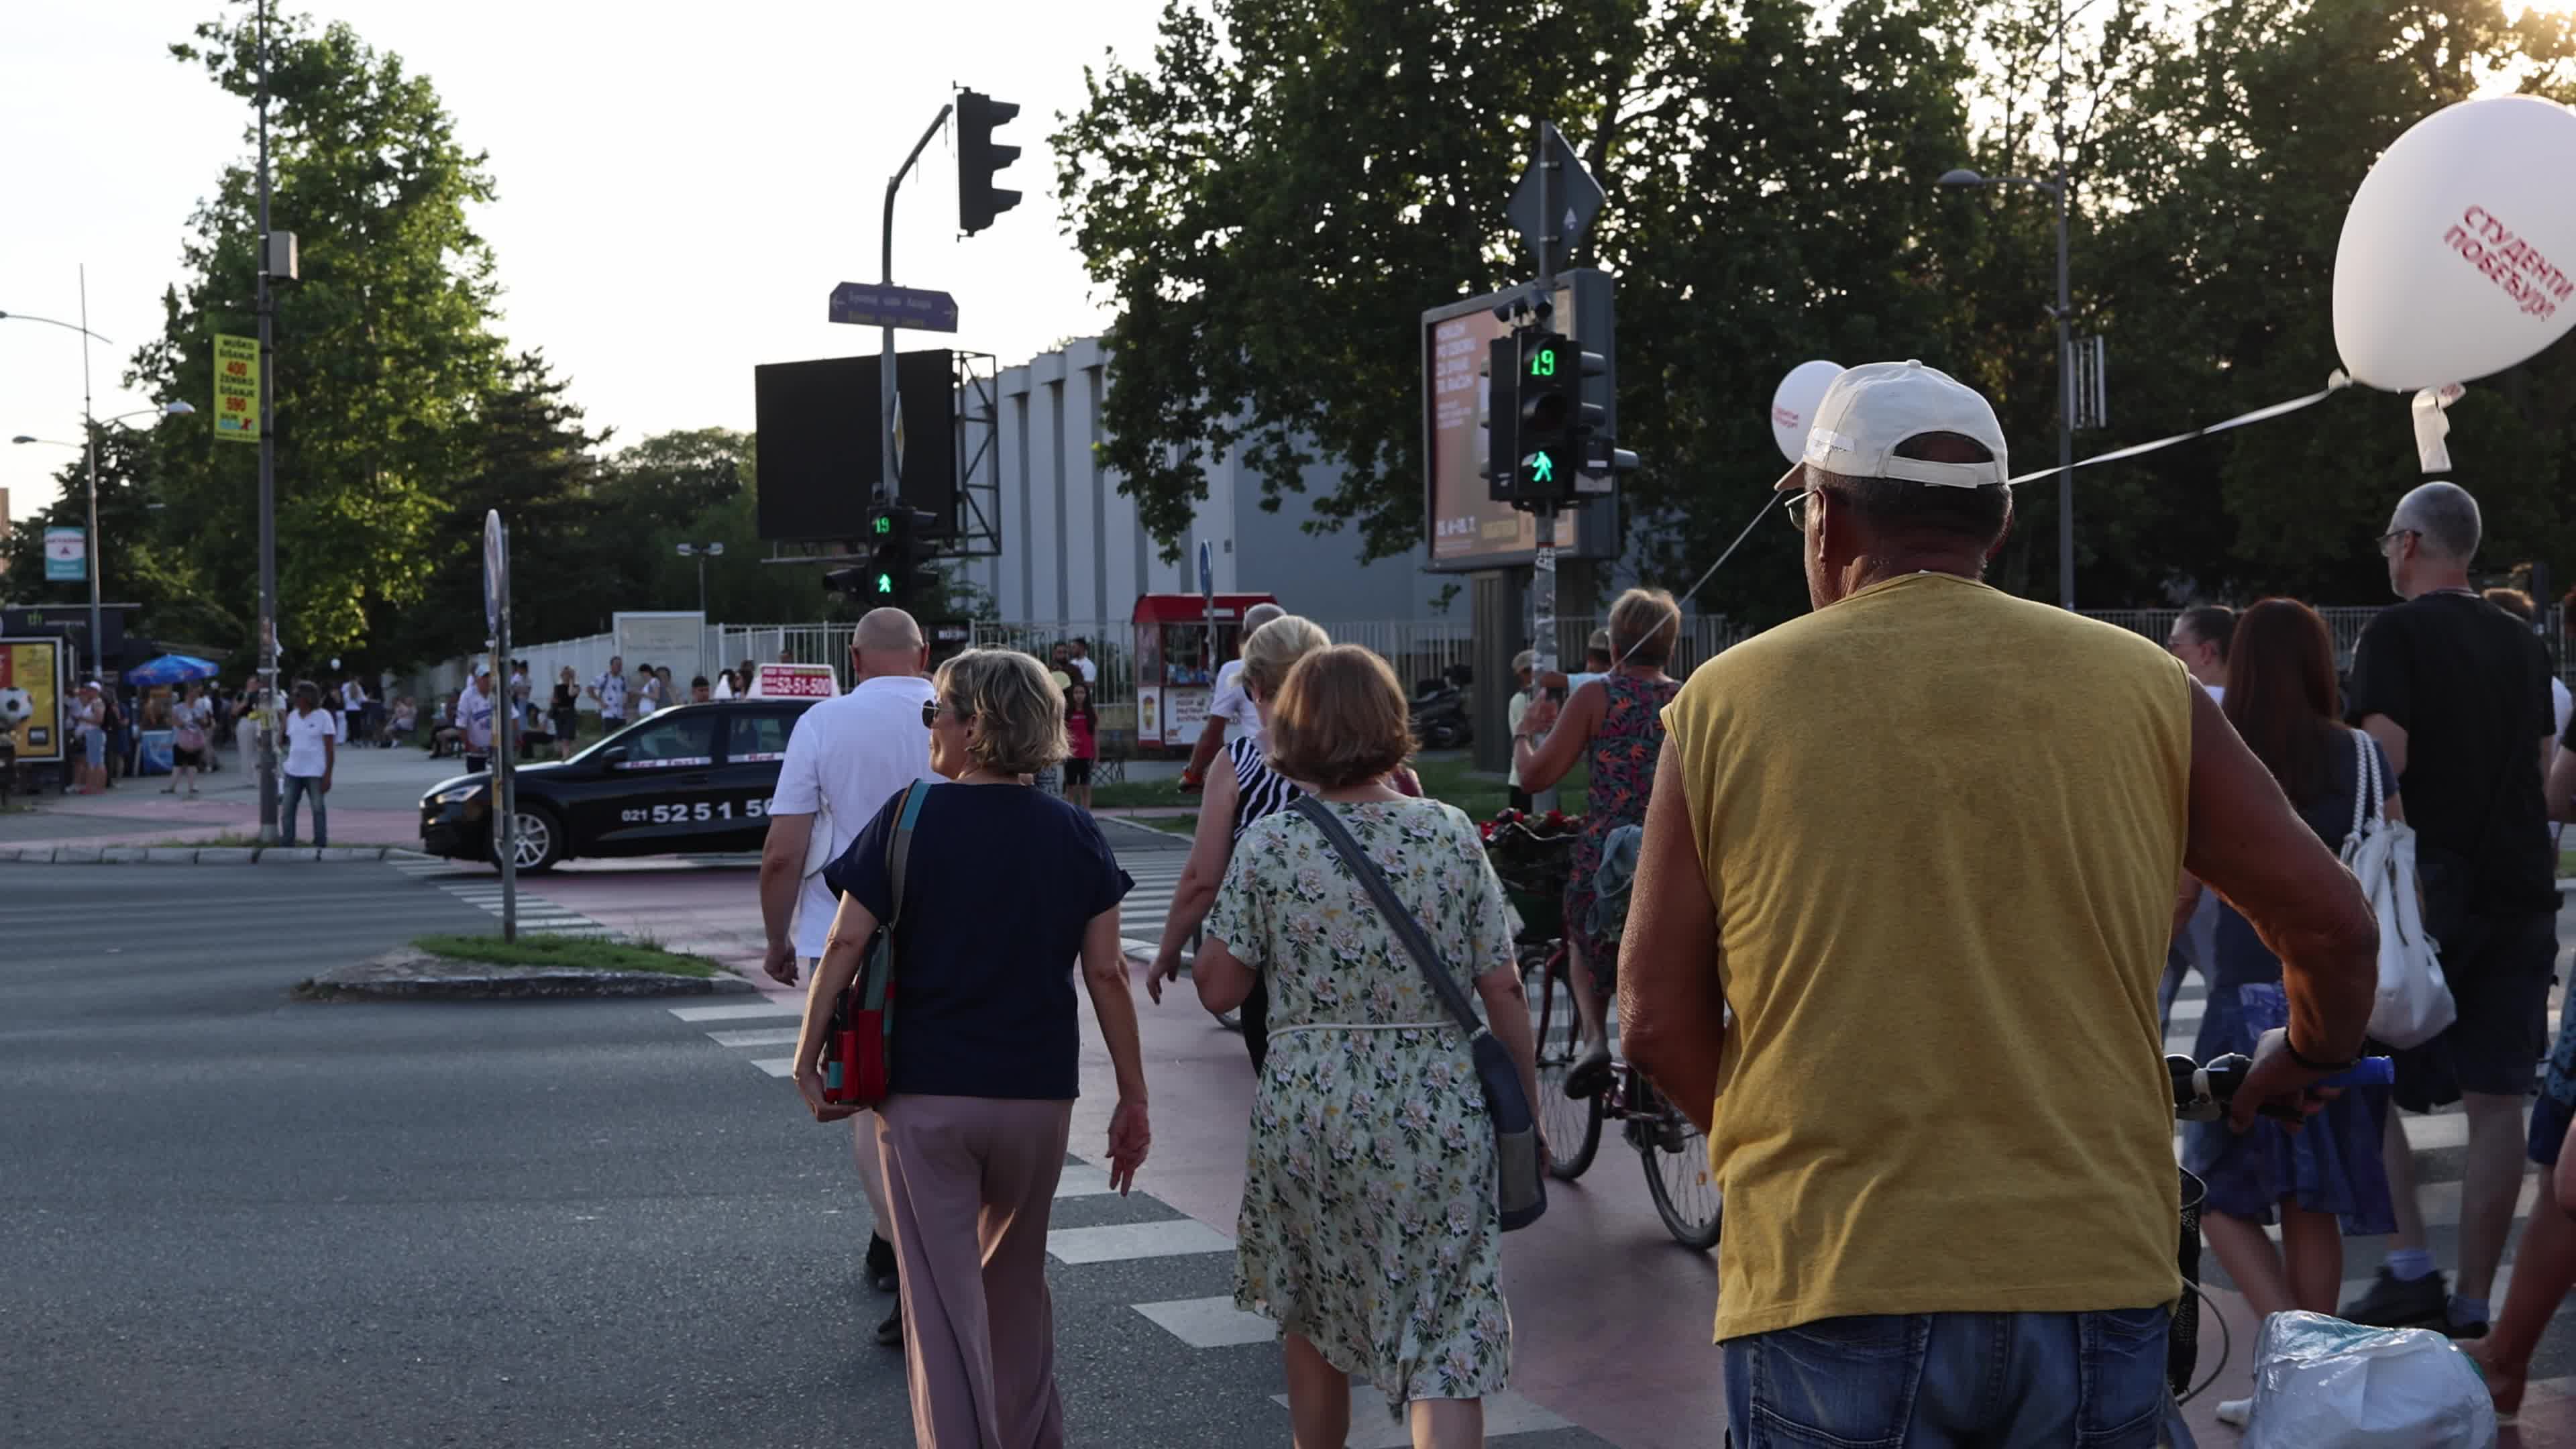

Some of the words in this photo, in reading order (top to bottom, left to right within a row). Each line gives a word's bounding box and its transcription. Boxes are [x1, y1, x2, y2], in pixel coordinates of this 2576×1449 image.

[2464, 205, 2573, 300] СТУДЕНТИ
[227, 361, 247, 376] 400
[1531, 350, 1554, 376] 19
[875, 517, 890, 533] 19
[777, 677, 831, 694] 52-51-500
[622, 809, 647, 822] 021
